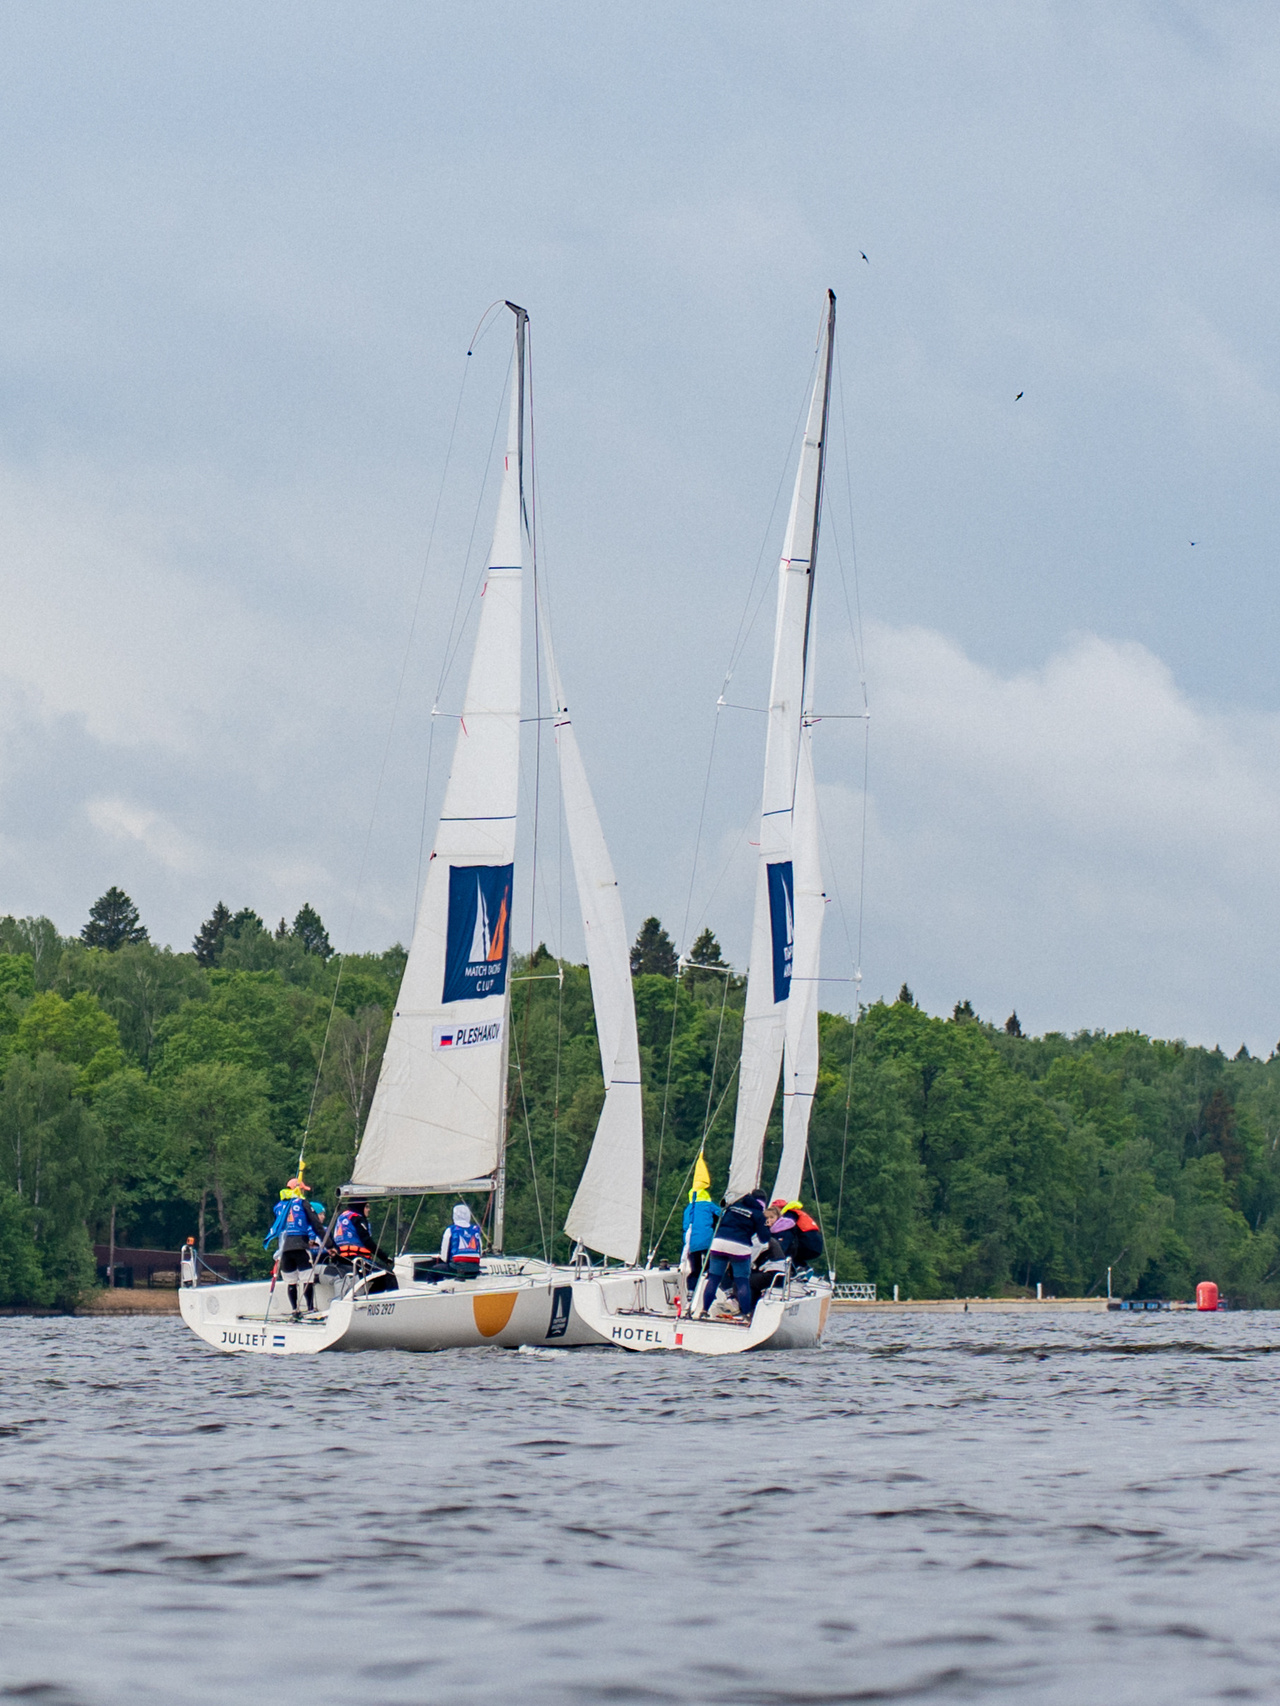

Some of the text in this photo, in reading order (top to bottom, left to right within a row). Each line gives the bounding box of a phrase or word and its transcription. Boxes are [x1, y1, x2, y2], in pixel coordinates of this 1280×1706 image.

[465, 965, 487, 977] MATCH
[456, 1023, 500, 1045] PLESHAKOV
[490, 1264, 516, 1275] JULIET
[367, 1304, 380, 1316] RUS
[221, 1331, 267, 1347] JULIET
[612, 1326, 662, 1343] HOTEL
